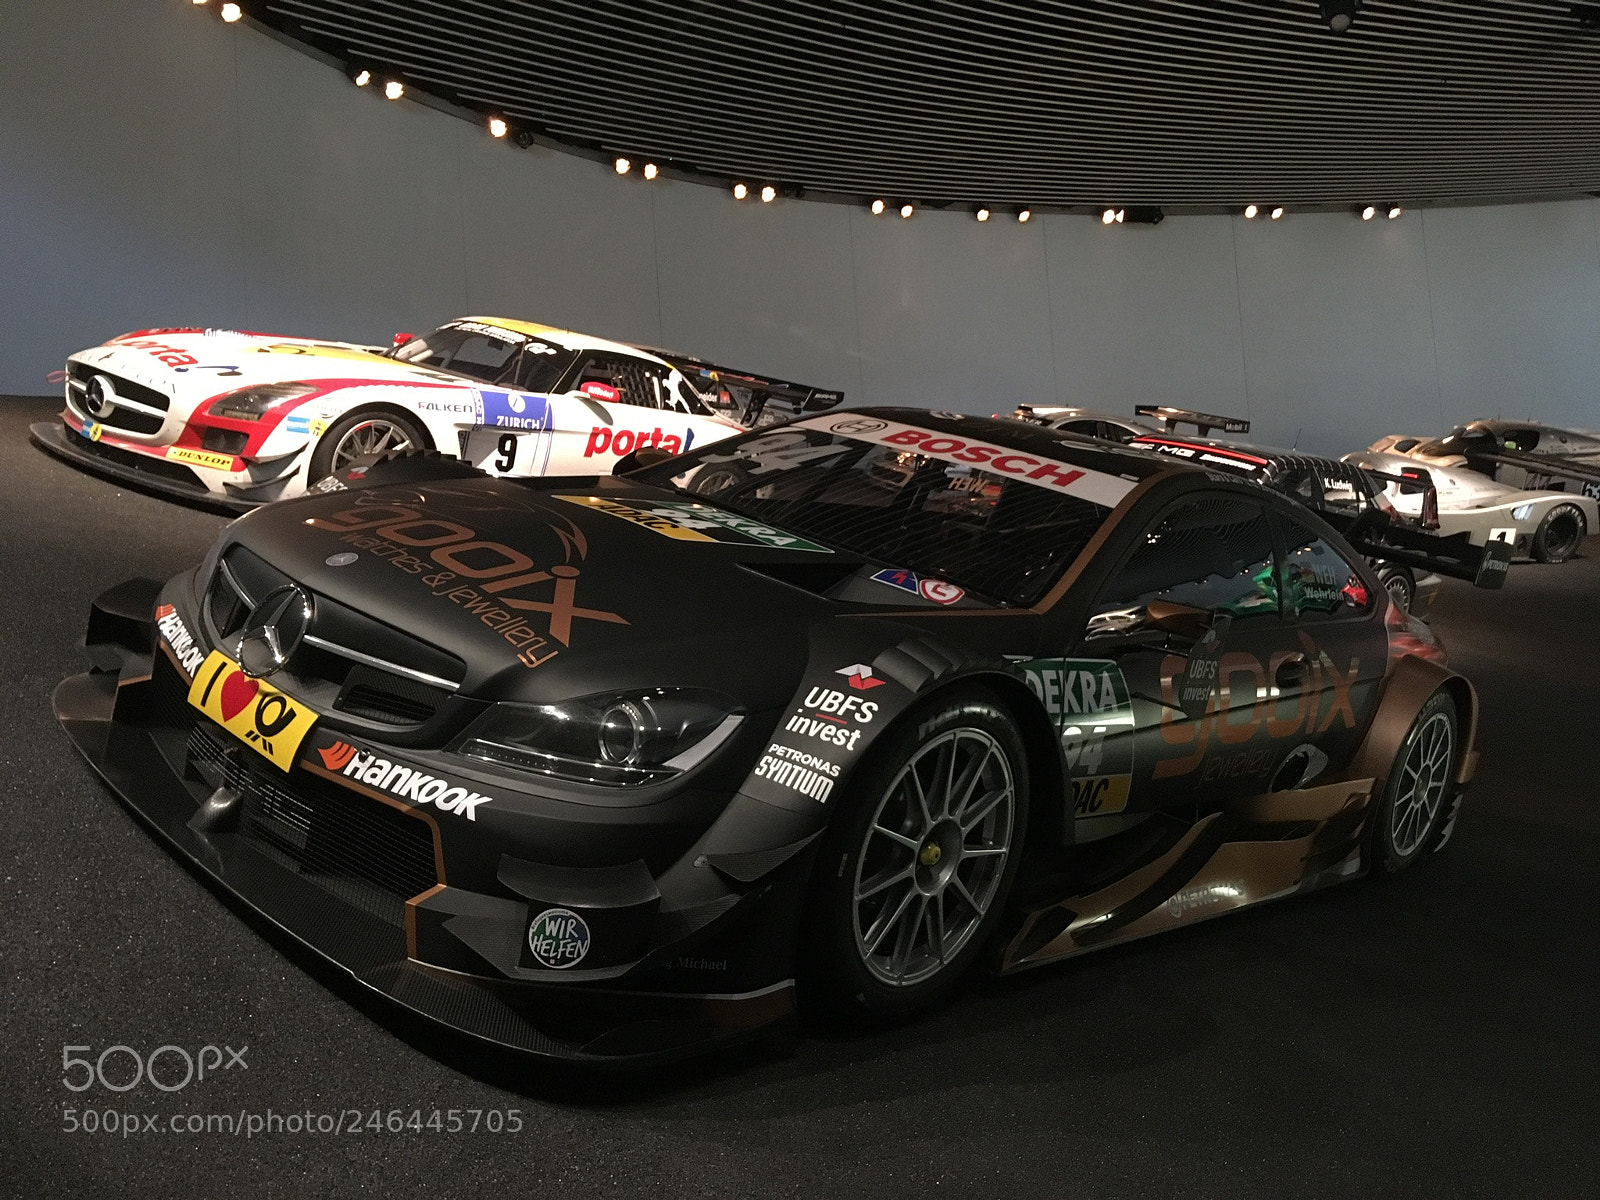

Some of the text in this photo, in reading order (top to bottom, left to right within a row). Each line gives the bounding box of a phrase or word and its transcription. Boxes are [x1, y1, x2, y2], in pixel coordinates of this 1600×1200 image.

[418, 401, 473, 413] FALKEN
[496, 415, 541, 430] ZURICH
[178, 450, 231, 466] DUNLOP
[494, 433, 518, 473] 9
[881, 429, 1086, 487] BOSCH
[593, 499, 680, 530] ADAC
[680, 502, 796, 547] DEKRA
[303, 505, 633, 649] gooix
[1304, 586, 1345, 601] Wehrlein
[338, 531, 560, 669] watches & jewellery
[1189, 659, 1218, 680] UBFS
[803, 685, 880, 725] UBFS
[1183, 680, 1212, 702] invest
[784, 708, 862, 751] invest
[768, 743, 842, 778] PETRONAS
[754, 755, 835, 804] SYNTIUM
[545, 917, 579, 939] WIR
[531, 933, 588, 960] HELFEN
